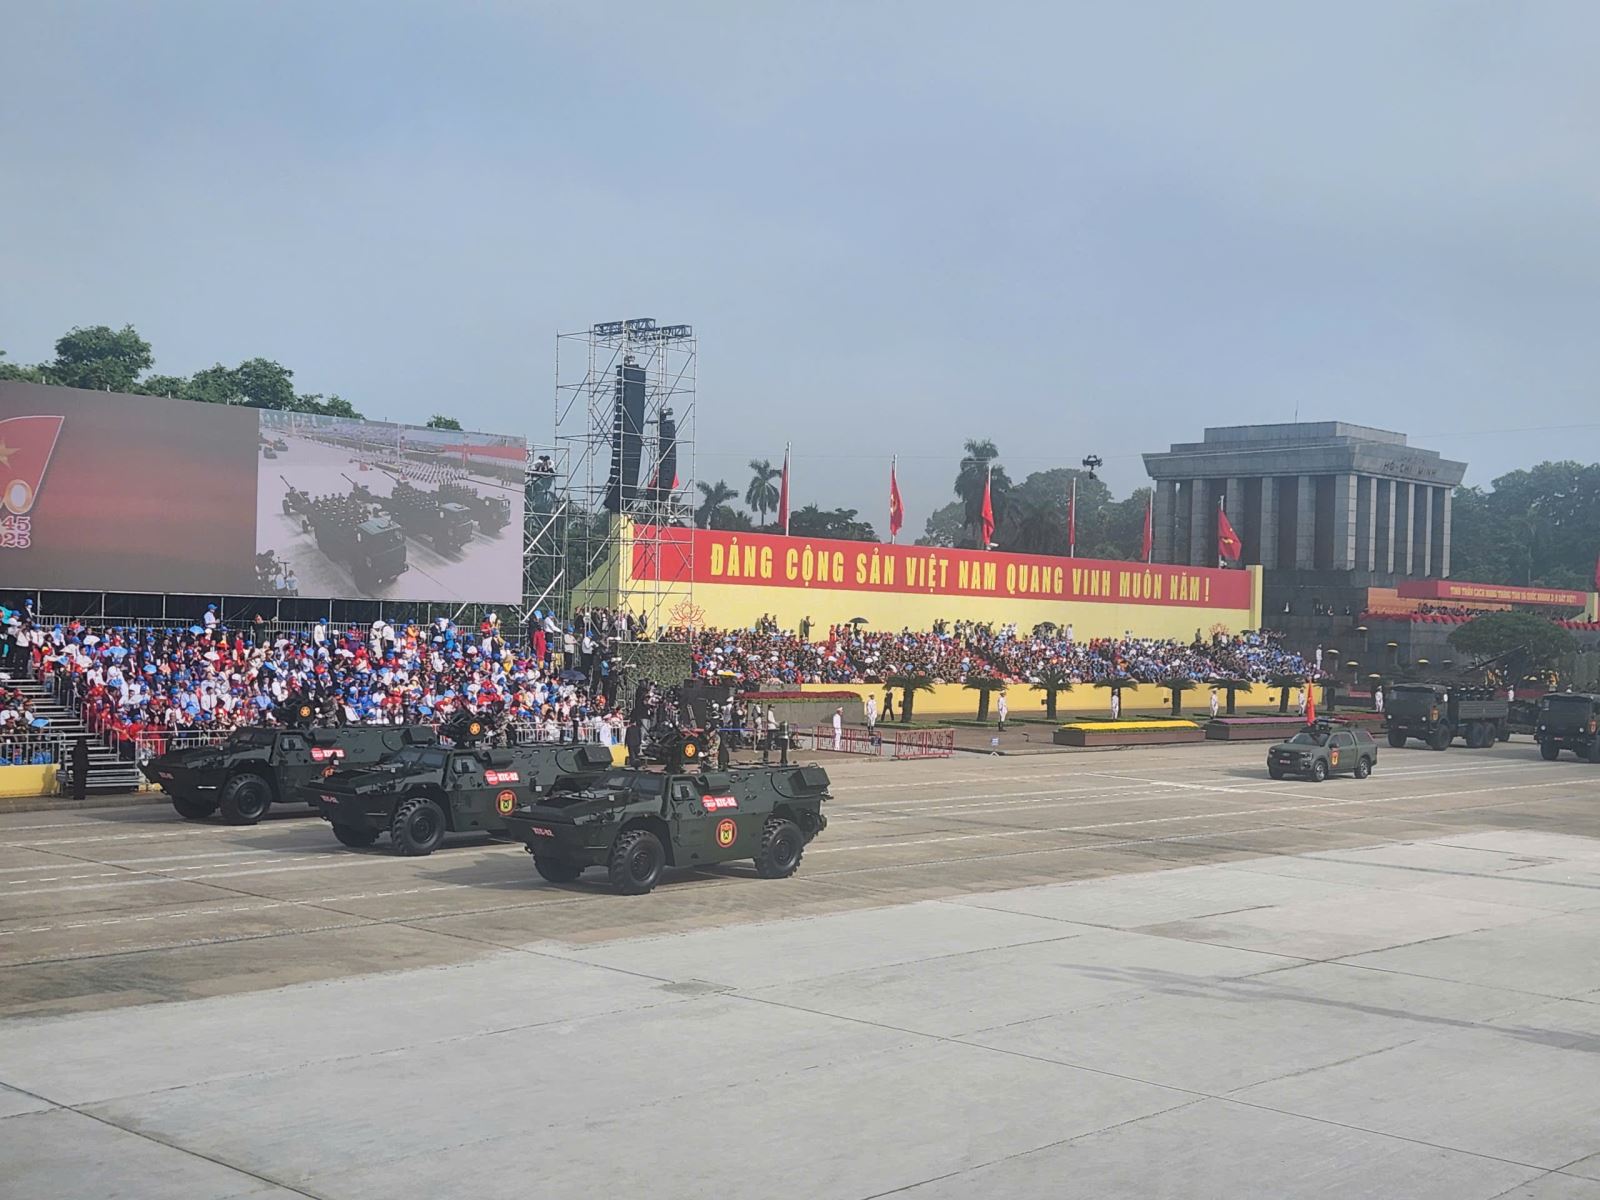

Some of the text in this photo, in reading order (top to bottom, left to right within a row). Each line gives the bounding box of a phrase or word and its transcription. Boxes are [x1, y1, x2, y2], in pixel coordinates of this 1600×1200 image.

[710, 537, 773, 579] ĐẢNG
[786, 545, 844, 587] CỘNG
[856, 547, 895, 585] SẢN
[905, 554, 949, 593] VIỆT
[958, 560, 997, 591] NAM
[1006, 564, 1063, 595] QUANG
[1072, 568, 1111, 597] VINH
[1119, 569, 1162, 600] MUÔN
